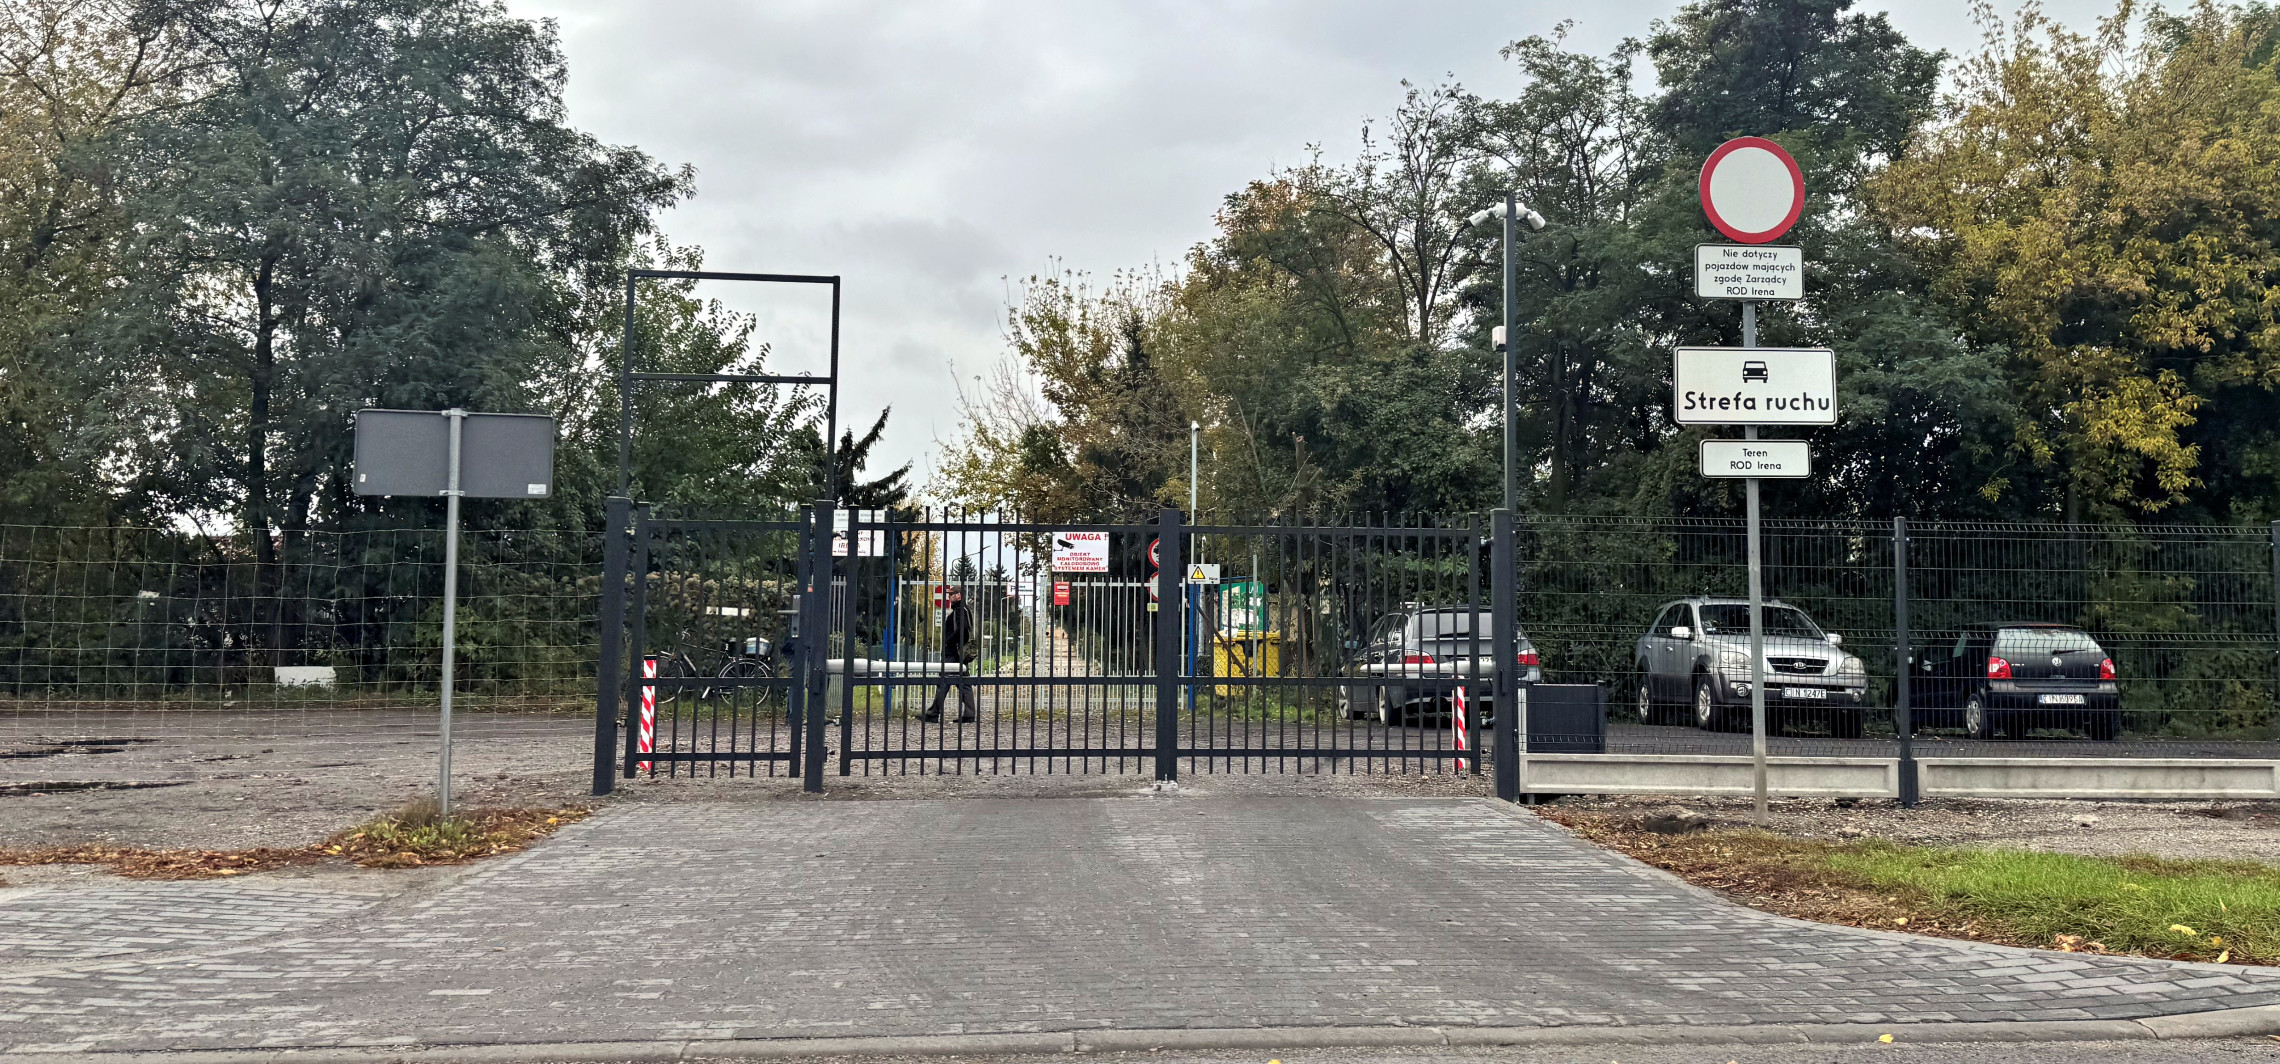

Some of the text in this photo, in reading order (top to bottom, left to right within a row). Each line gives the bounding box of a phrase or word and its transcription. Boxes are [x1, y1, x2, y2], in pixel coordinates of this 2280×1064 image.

[1723, 249, 1778, 261] Nie dotyczy
[1705, 261, 1796, 273] pojazdów mających
[1714, 274, 1787, 286] zgodę Zarządcy
[1726, 286, 1775, 296] ROD Irena
[1684, 390, 1830, 411] Strefa ruchu
[1742, 448, 1768, 458] Teren
[1730, 460, 1782, 471] ROD Irena
[1065, 533, 1101, 541] UWAGA
